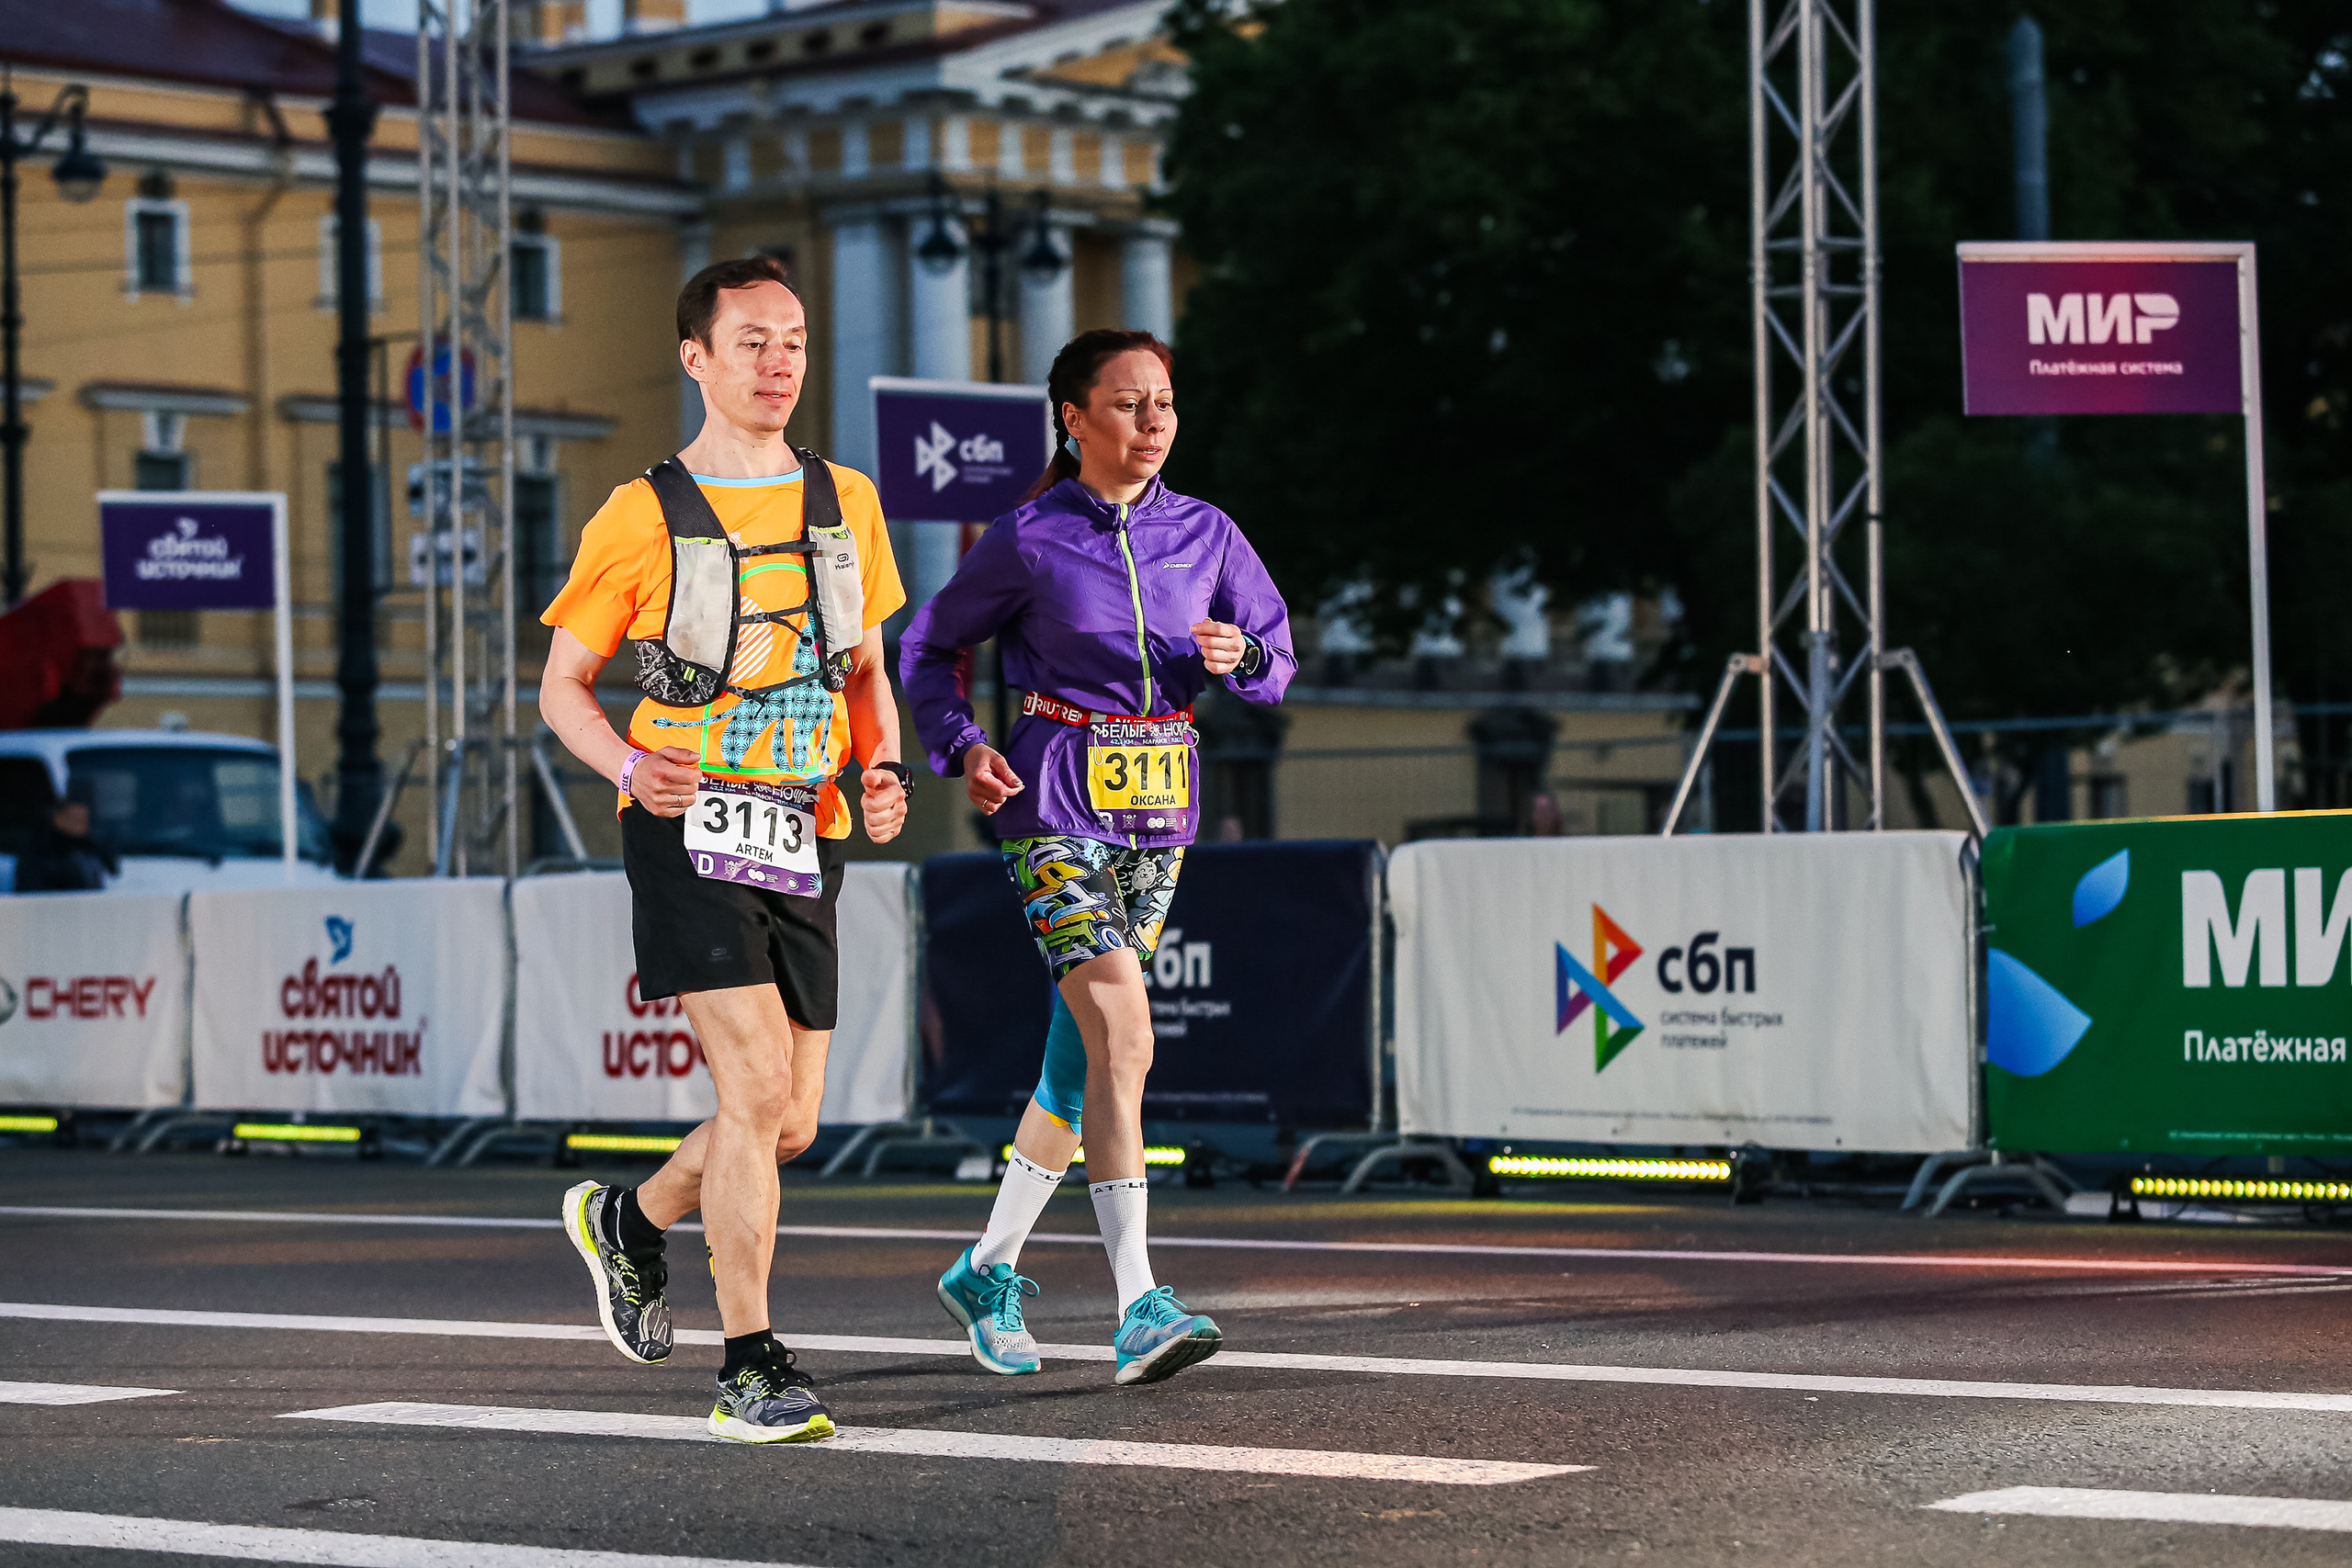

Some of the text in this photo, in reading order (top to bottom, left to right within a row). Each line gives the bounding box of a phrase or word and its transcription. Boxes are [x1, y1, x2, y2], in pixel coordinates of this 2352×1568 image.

[2027, 292, 2180, 344] МИР
[2120, 361, 2183, 376] система
[1102, 724, 1147, 739] БЕЛЫЕ
[1104, 751, 1186, 791] 3111
[1130, 794, 1177, 806] ОКСАНА
[703, 797, 803, 853] 3113
[697, 853, 715, 875] D
[735, 842, 775, 863] ARTEM
[1145, 927, 1212, 989] бп
[1657, 930, 1757, 994] сбп
[26, 976, 157, 1021] CHERY
[2183, 1029, 2347, 1063] Платёжная
